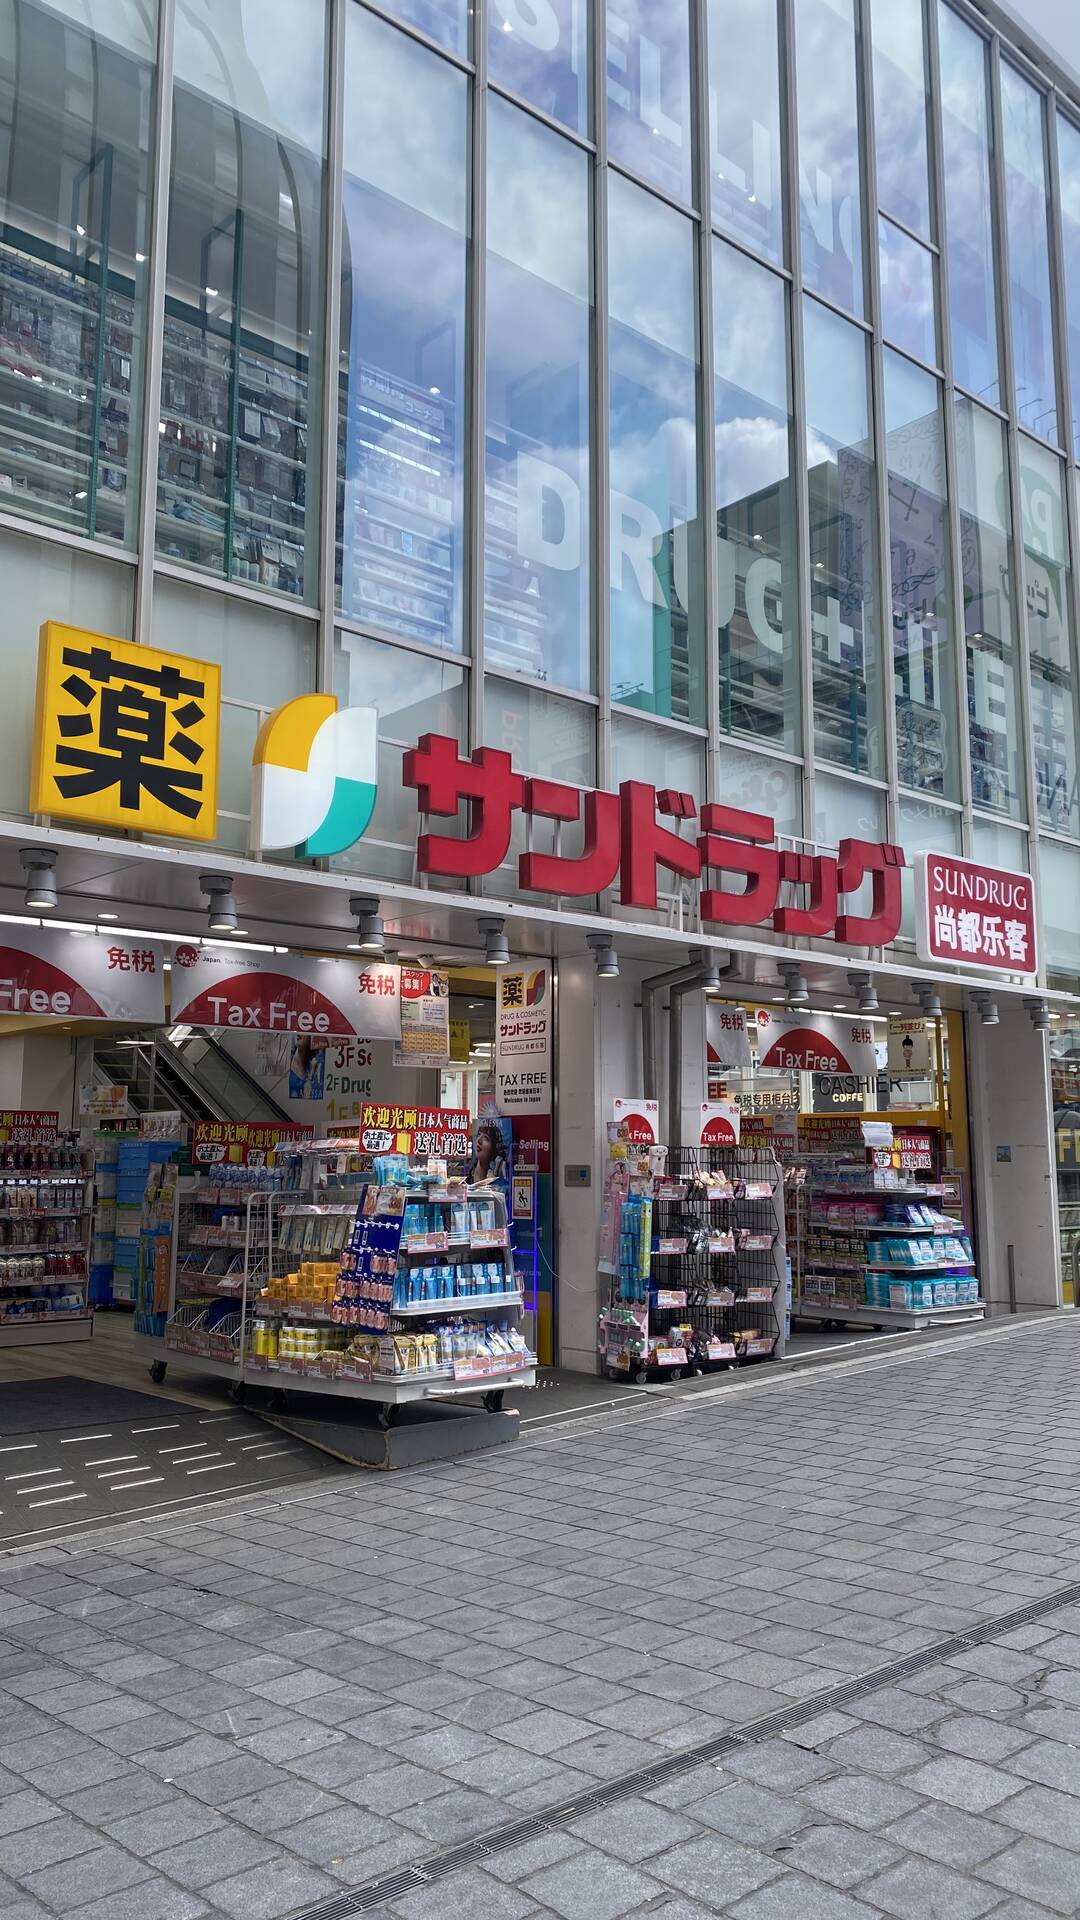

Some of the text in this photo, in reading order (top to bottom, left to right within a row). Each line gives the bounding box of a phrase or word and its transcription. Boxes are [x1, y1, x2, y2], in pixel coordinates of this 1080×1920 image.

[53, 646, 205, 820] 薬
[403, 733, 905, 946] サンドラッグ
[932, 865, 1028, 912] SUNDRUG
[933, 903, 1029, 963] 尚都乐客
[107, 946, 156, 973] 免税
[358, 972, 396, 996] 免税
[502, 976, 523, 1007] 薬
[207, 996, 330, 1032] Tax Free
[501, 1012, 515, 1021] DRUG
[520, 1009, 546, 1018] COSMETIC
[720, 1012, 744, 1031] 免税
[500, 1020, 547, 1037] サンドラッグ
[851, 1027, 873, 1044] 免税
[775, 1046, 838, 1072] Tax Free
[325, 1073, 340, 1091] 2F
[498, 1072, 547, 1087] TAX FREE
[819, 1073, 903, 1096] CASHIER
[362, 1106, 468, 1130] 欢迎光顾 日本人气商品
[194, 1123, 249, 1143] 欢迎光顾
[414, 1132, 468, 1156] 送礼首选
[633, 1130, 652, 1140] Free
[702, 1132, 734, 1142] Tax Free
[518, 1139, 550, 1152] Selling
